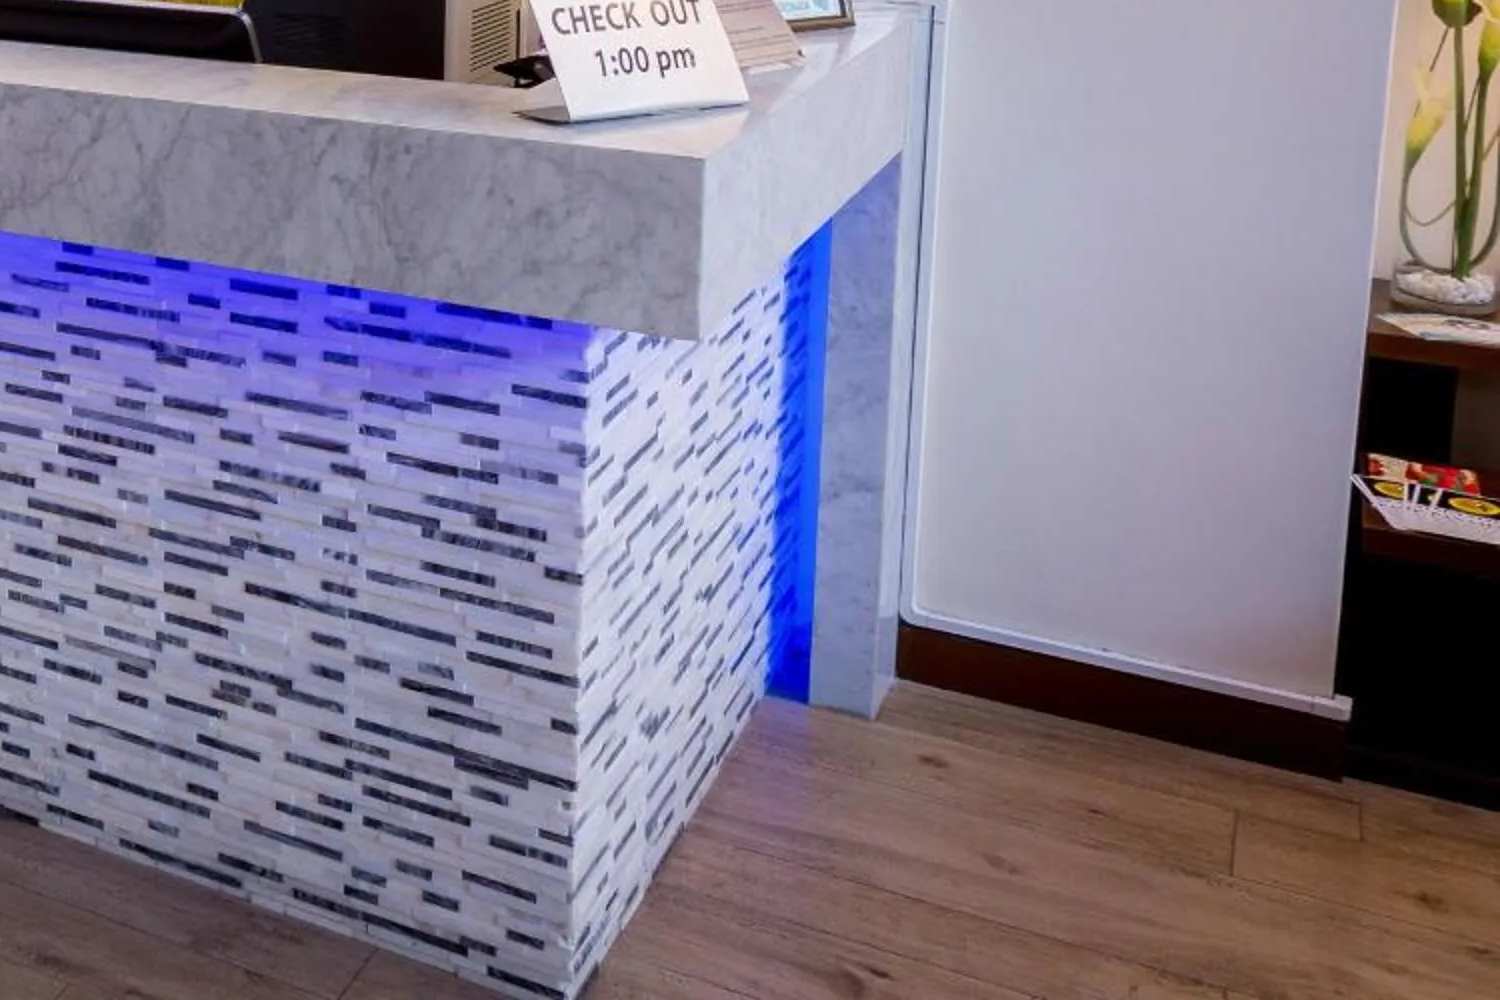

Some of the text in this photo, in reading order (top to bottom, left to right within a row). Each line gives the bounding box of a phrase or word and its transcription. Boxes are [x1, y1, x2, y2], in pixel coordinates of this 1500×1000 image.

[551, 1, 642, 35] CHECK
[594, 46, 696, 79] 1:00 pm
